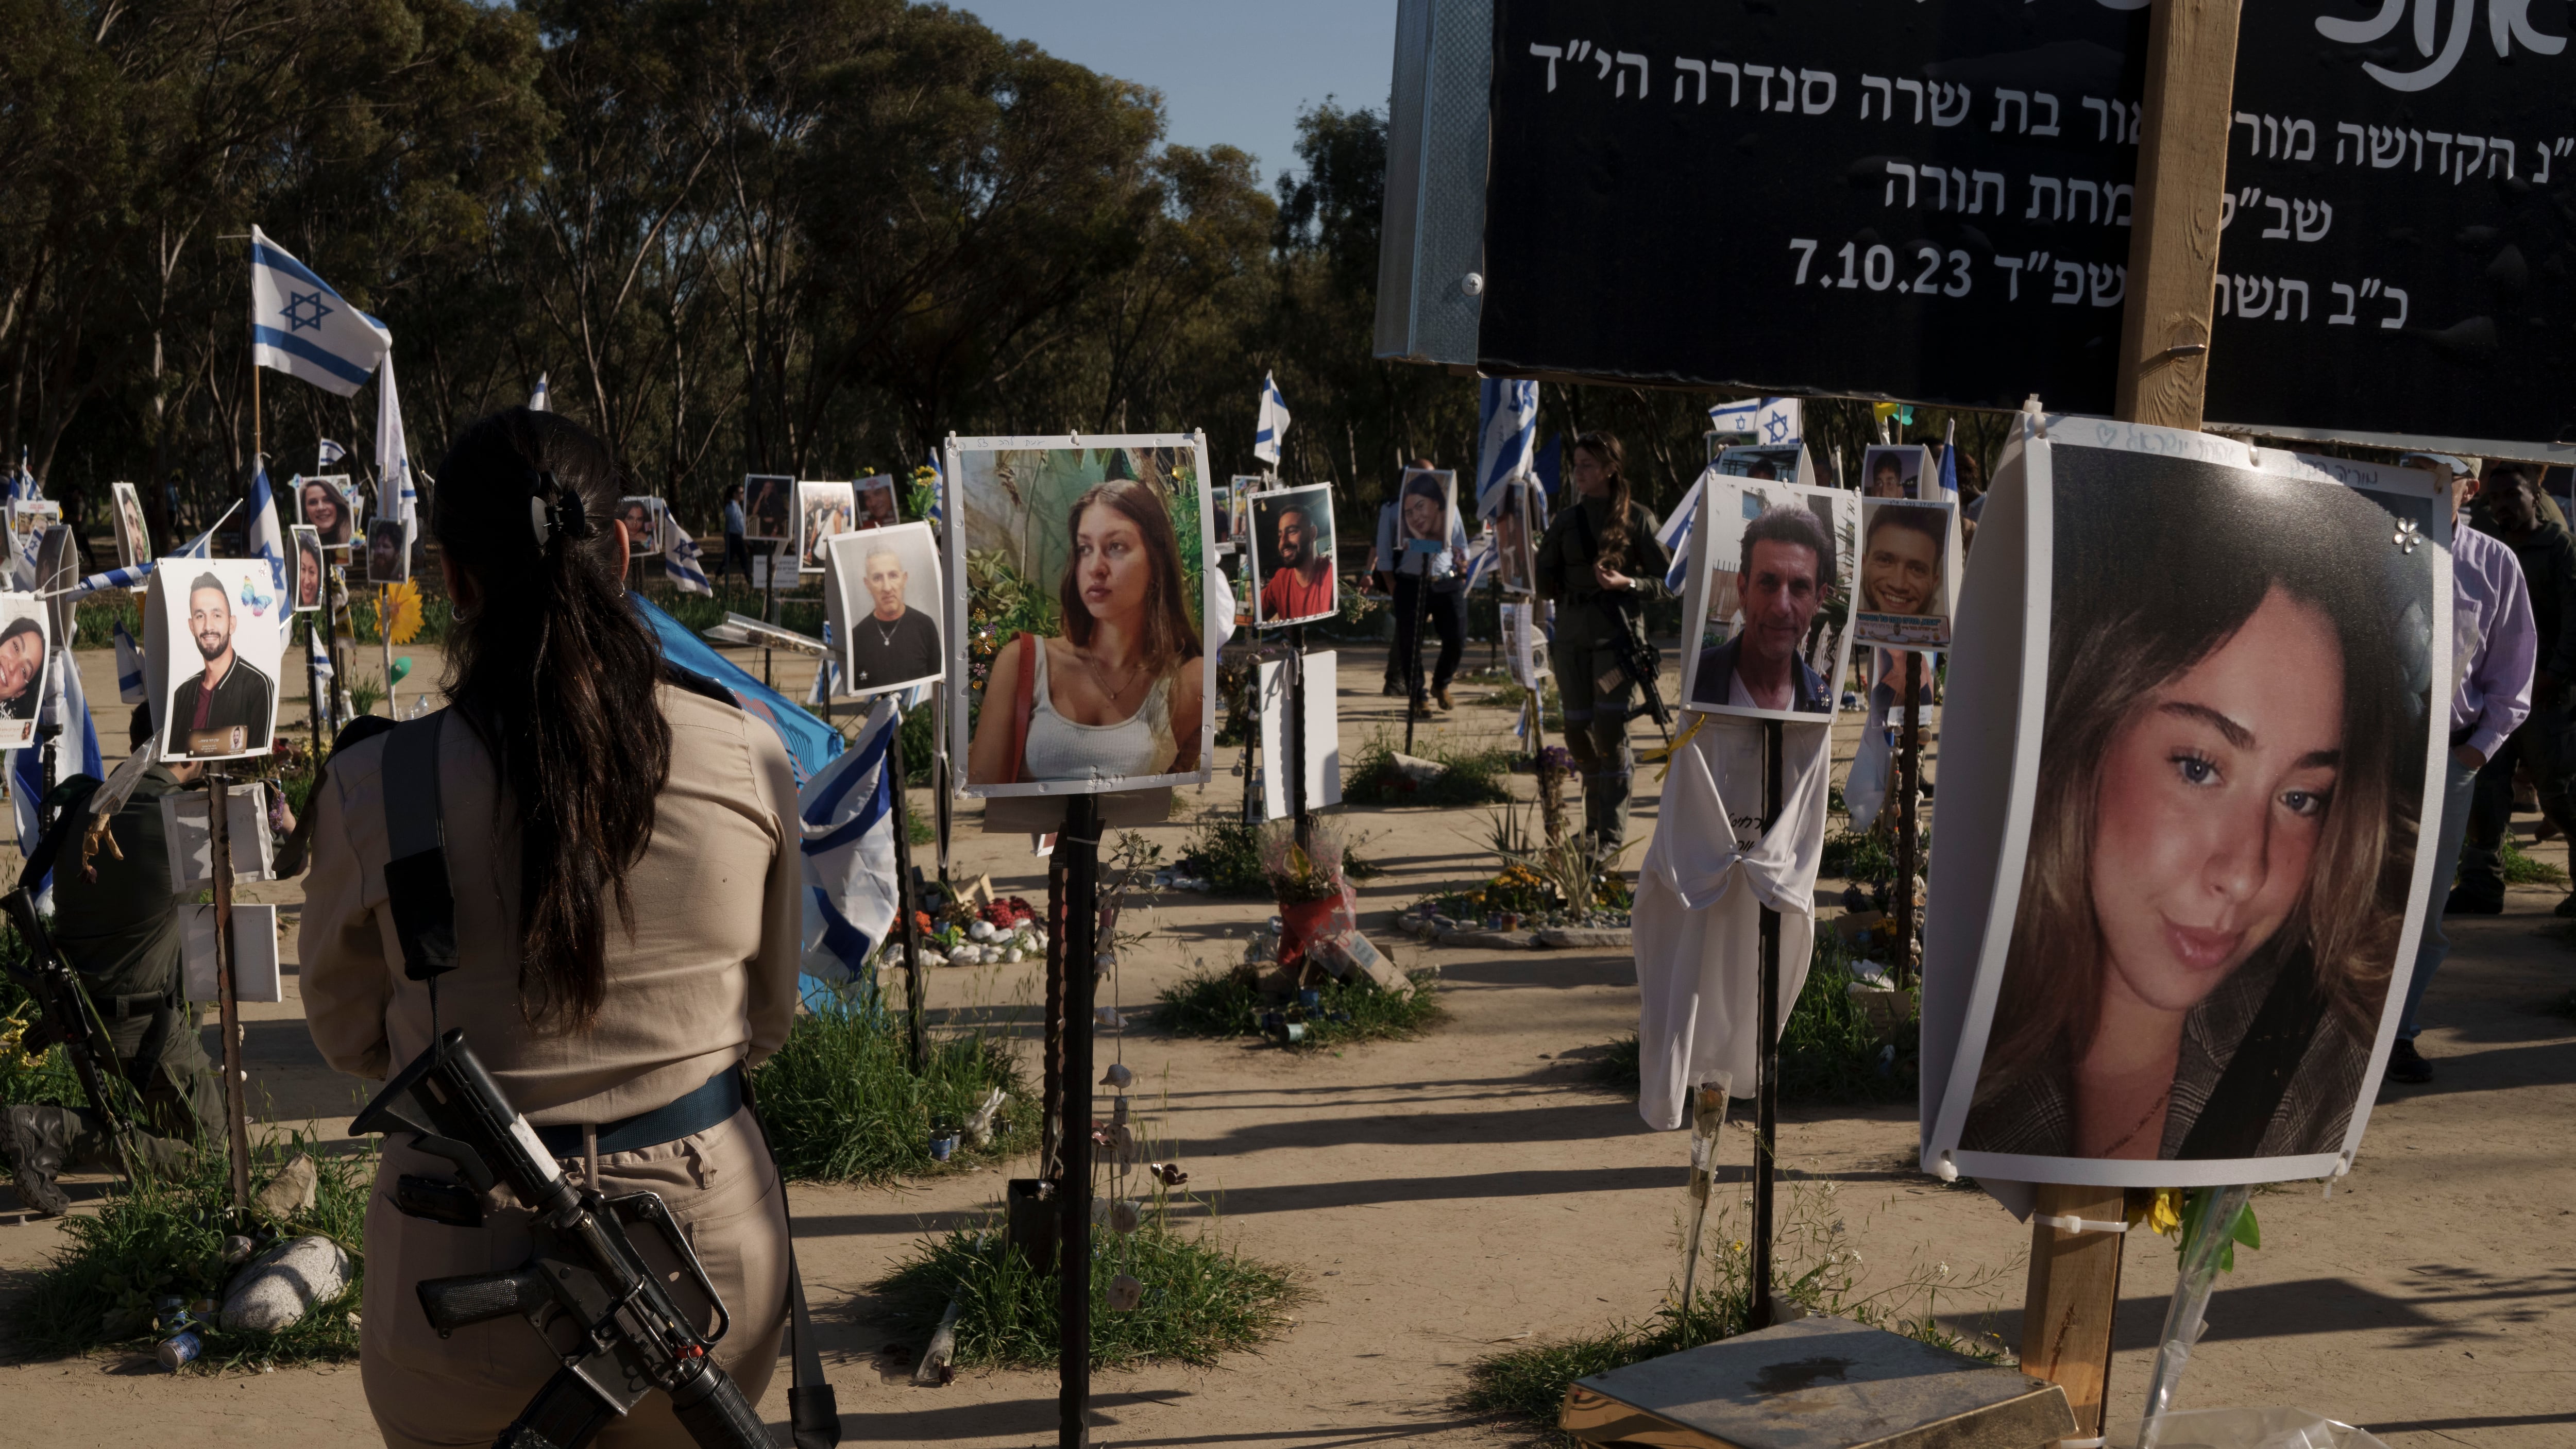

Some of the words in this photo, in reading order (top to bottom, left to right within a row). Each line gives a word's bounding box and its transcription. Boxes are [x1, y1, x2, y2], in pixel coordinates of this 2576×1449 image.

[1529, 39, 1649, 99] הי"ד
[1674, 56, 1837, 115] סנדרה
[1860, 73, 1971, 127] שרה
[1990, 87, 2060, 137] בת
[2227, 110, 2316, 161] מור
[2336, 121, 2515, 186] הקדושה
[2532, 136, 2575, 184] "נ
[1885, 160, 2005, 216] תורה
[2026, 174, 2135, 226] מחת
[1789, 238, 1972, 297] 7.10.23
[1994, 251, 2127, 308] שפ"ד
[2214, 273, 2309, 322] תשר
[2328, 277, 2409, 329] כ"ב
